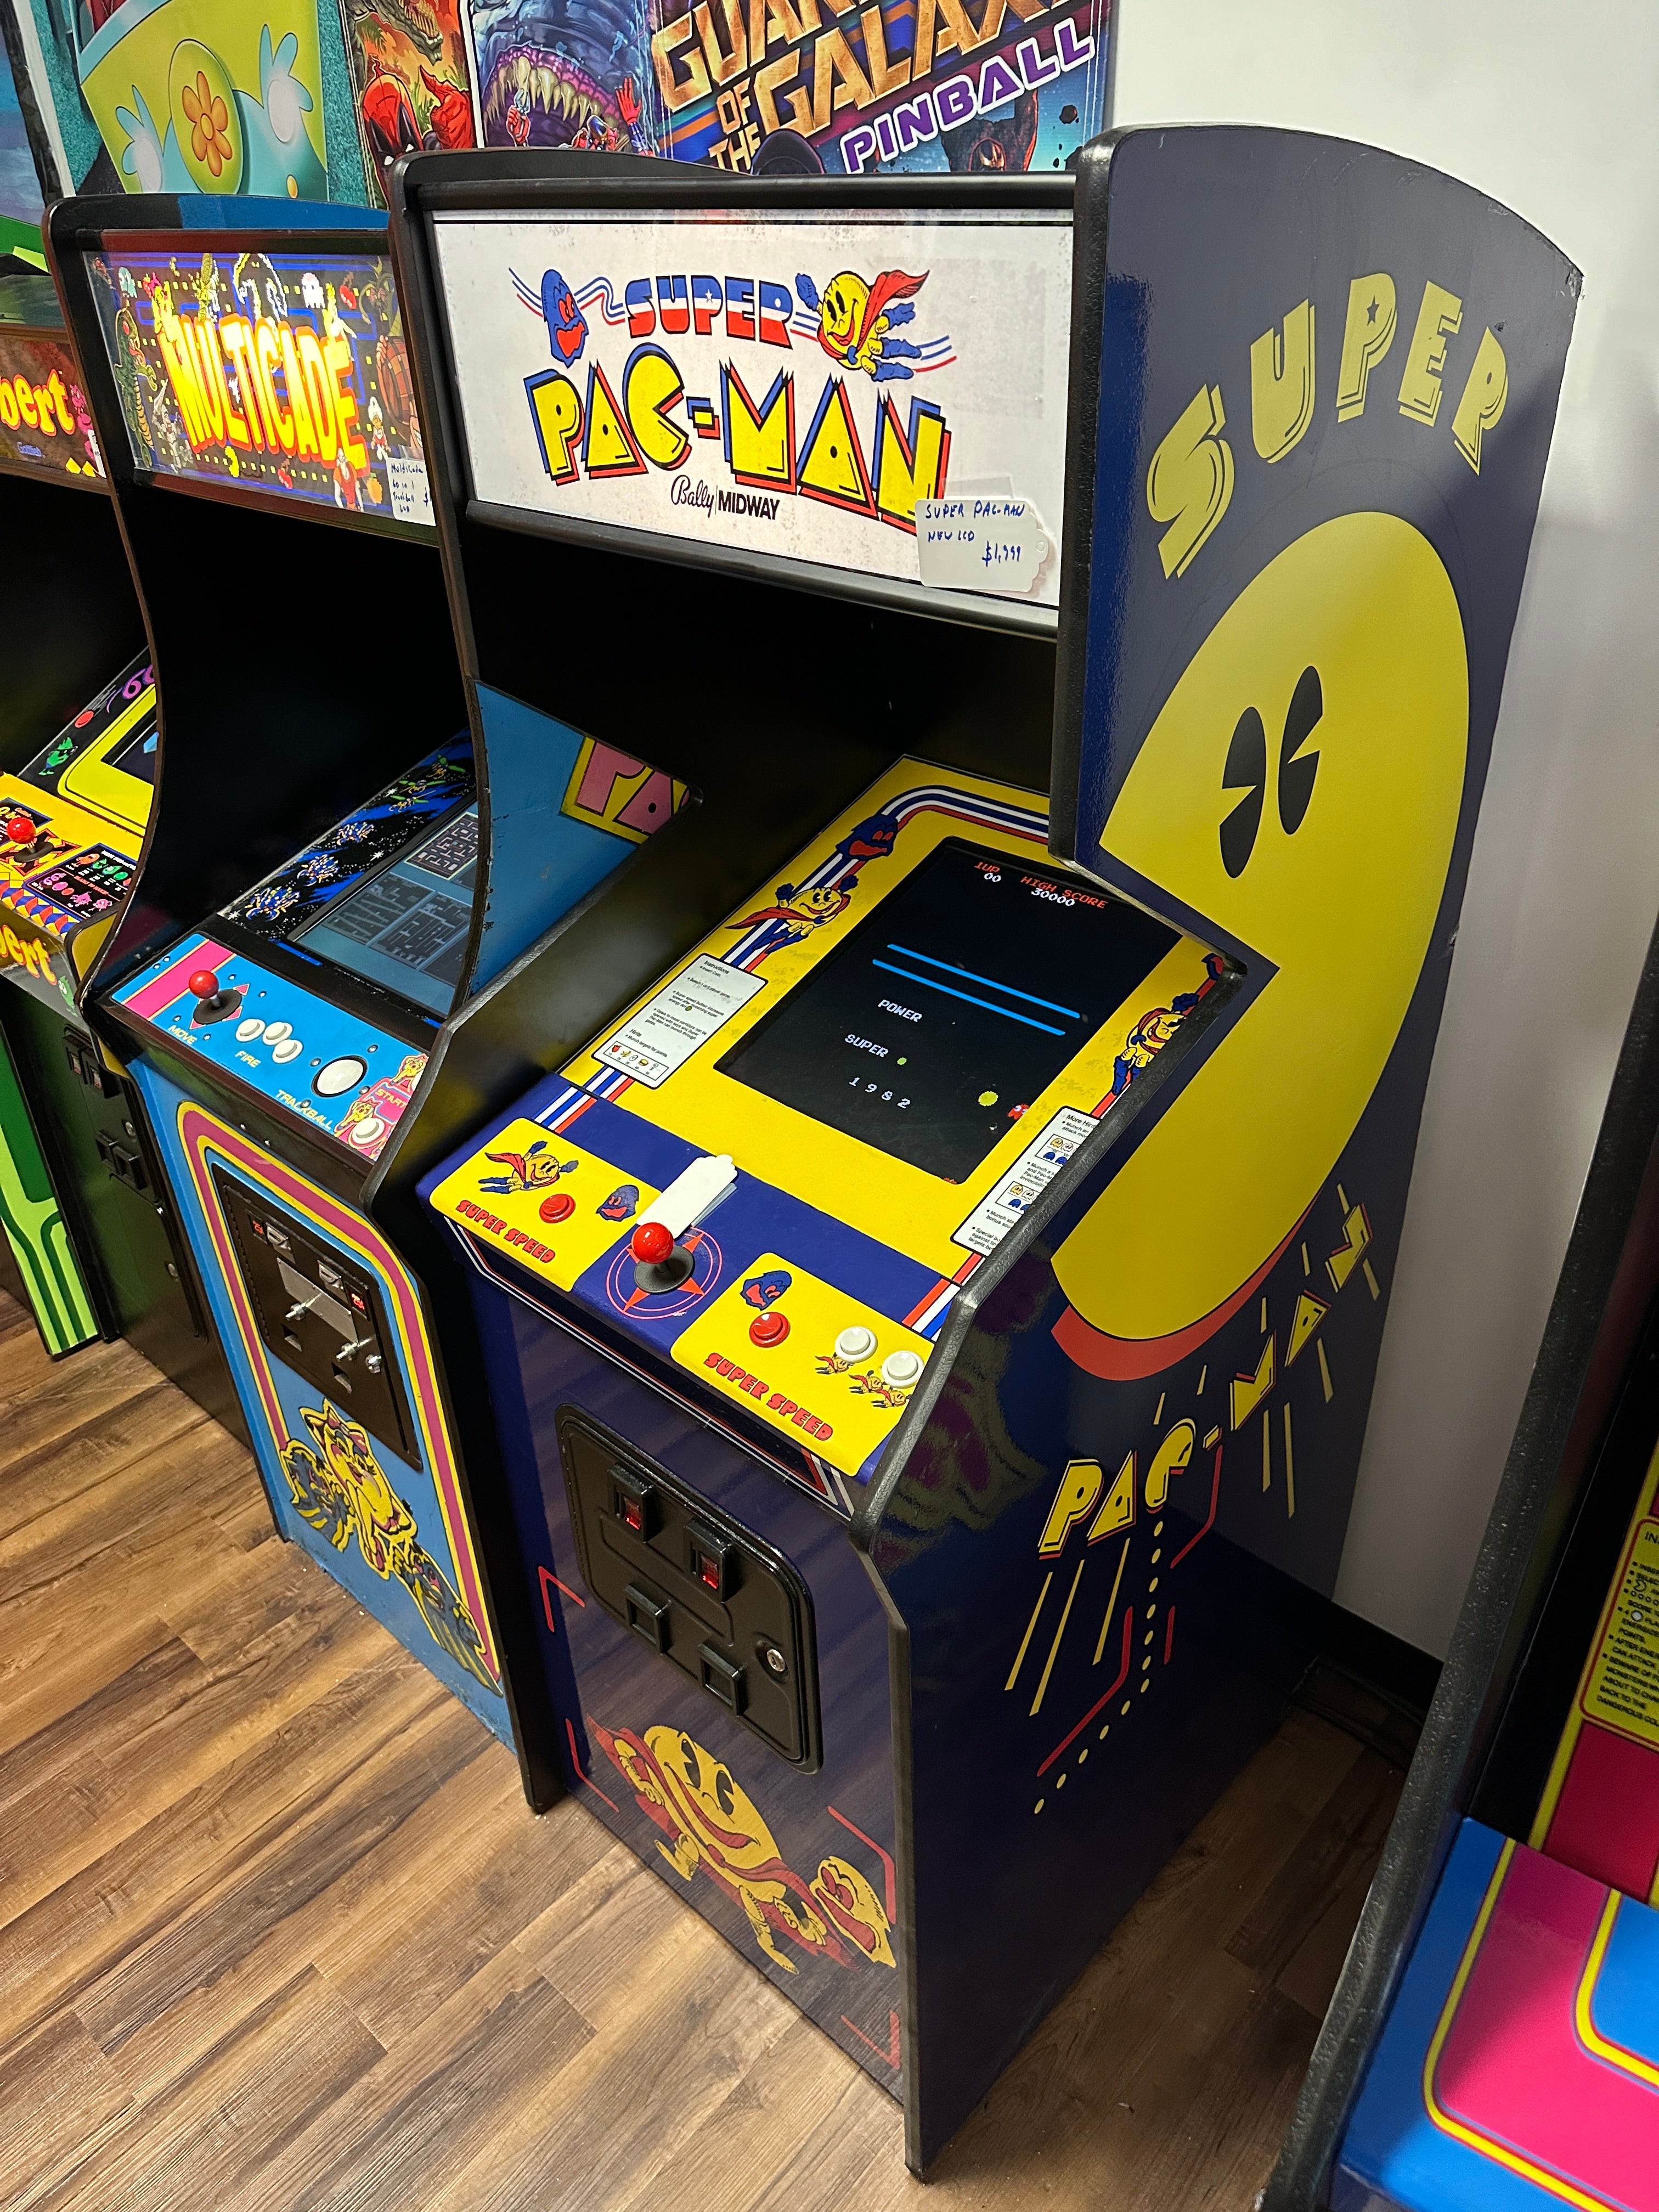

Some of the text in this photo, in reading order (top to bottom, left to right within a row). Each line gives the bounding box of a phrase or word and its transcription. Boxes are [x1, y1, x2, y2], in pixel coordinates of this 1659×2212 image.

[840, 17, 1095, 174] PINBALL
[716, 77, 751, 134] OF
[708, 122, 761, 172] THE
[624, 275, 793, 349] SUPER
[157, 313, 371, 478] MULTICADE
[1147, 273, 1508, 579] SUPER
[523, 342, 952, 535] PAC-MAN
[670, 475, 781, 521] Bally MIDWAY
[925, 503, 964, 519] SUPER
[928, 530, 953, 543] NEW
[974, 862, 1001, 873] 1UP
[984, 872, 1002, 883] 00
[1020, 876, 1109, 909] HIGH SCORE
[1030, 887, 1076, 906] 30000
[704, 961, 730, 974] Instructions
[877, 999, 922, 1023] POWER
[167, 1025, 198, 1045] MOVE
[629, 1028, 642, 1037] Hints
[844, 1034, 889, 1058] SUPER
[234, 1051, 262, 1068] FIRE
[375, 1088, 408, 1109] START
[275, 1089, 334, 1130] TRACKBALL
[1066, 1114, 1082, 1123] More
[1066, 1122, 1082, 1131] Munch
[1024, 1171, 1045, 1182] Pac-Man
[1031, 1163, 1047, 1172] Munch
[986, 1215, 1002, 1224] bonus
[990, 1210, 1007, 1220] Munch
[455, 1199, 556, 1263] SUPER SPEED
[972, 1233, 990, 1243] against
[976, 1228, 994, 1238] Special
[968, 1237, 985, 1247] targets
[1037, 1203, 1372, 1560] PAC-MAN
[703, 1352, 833, 1441] SUPER SPEED
[1645, 1531, 1659, 1544] IN
